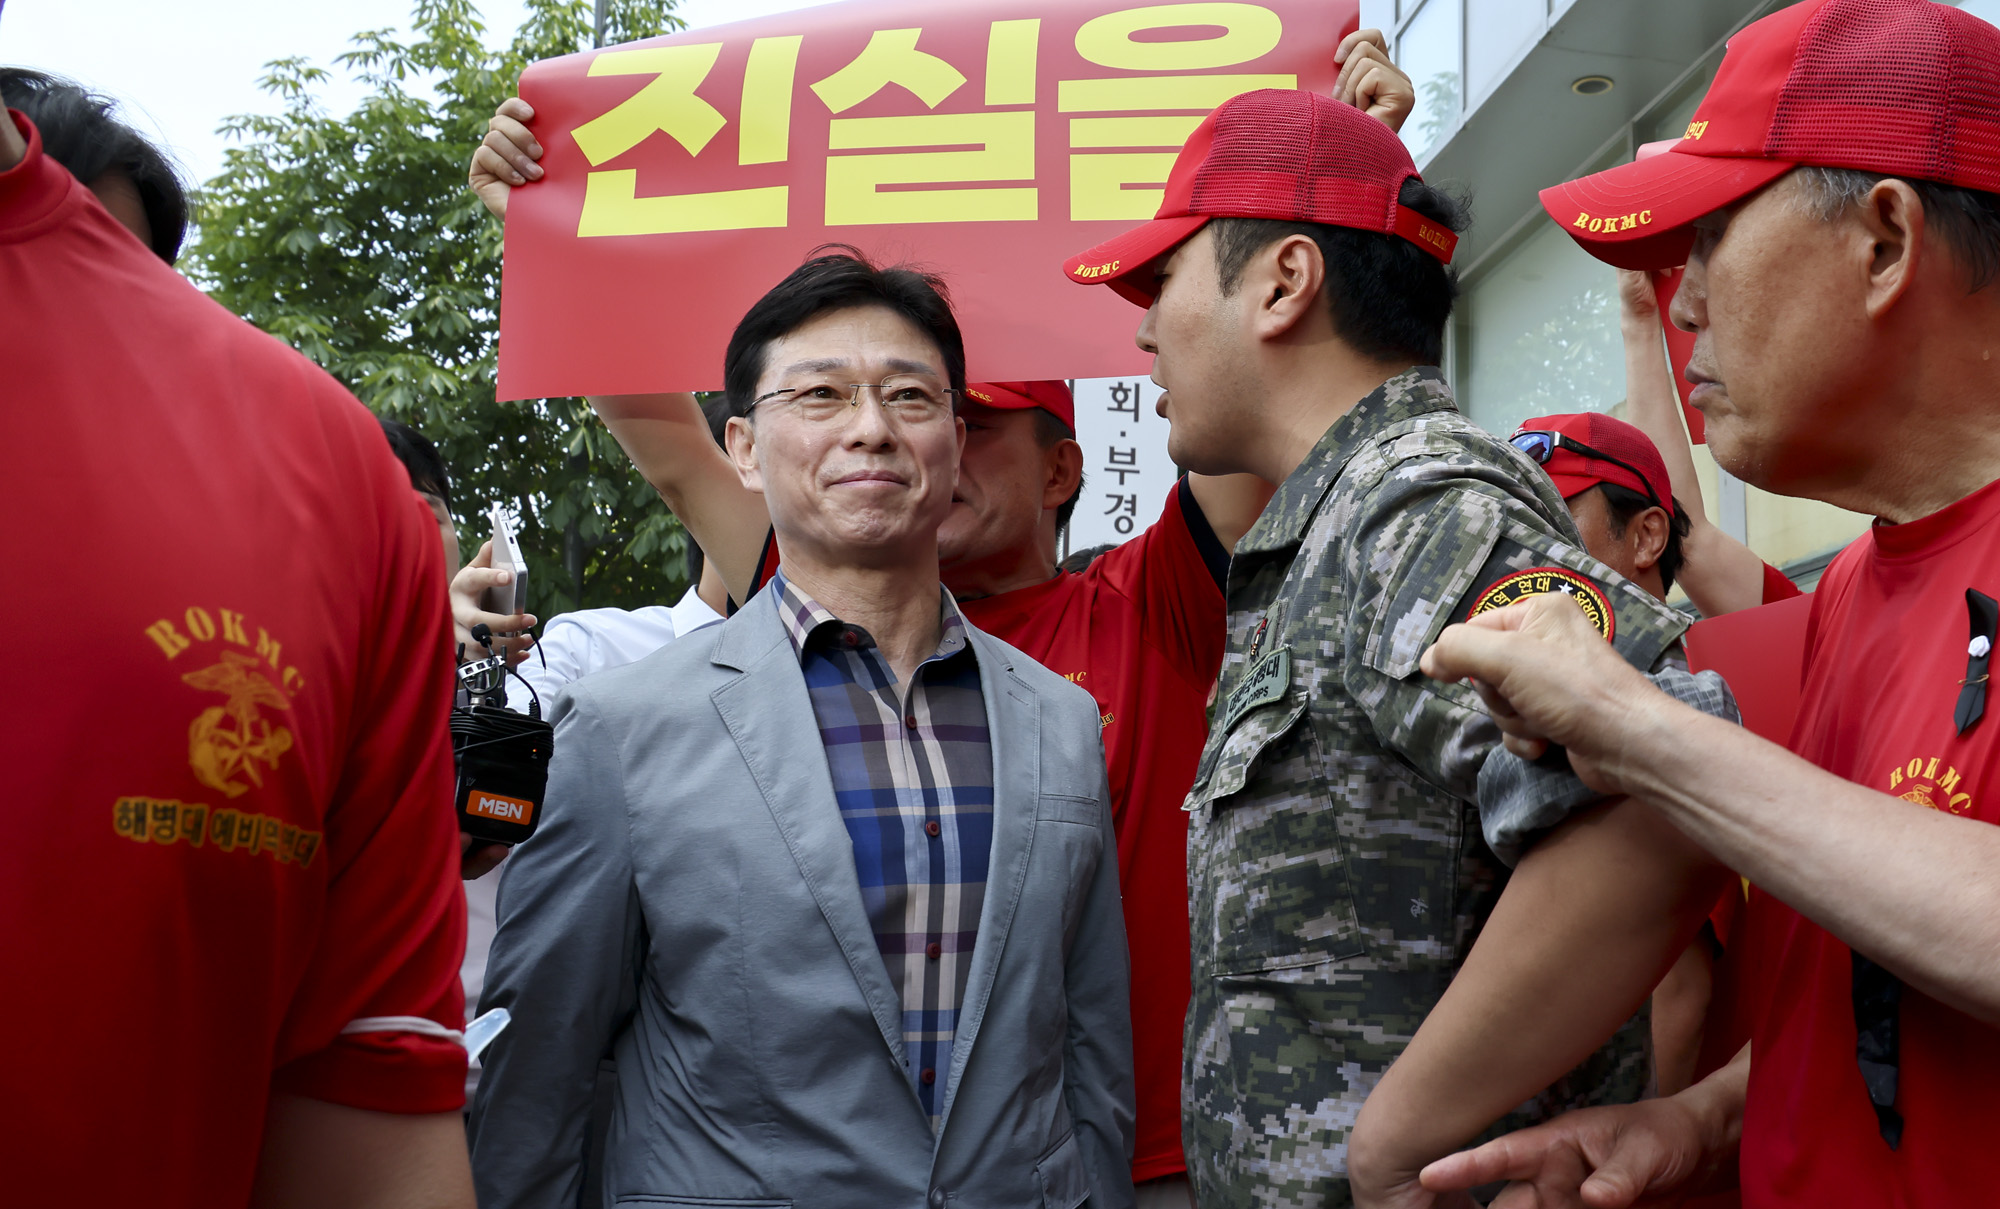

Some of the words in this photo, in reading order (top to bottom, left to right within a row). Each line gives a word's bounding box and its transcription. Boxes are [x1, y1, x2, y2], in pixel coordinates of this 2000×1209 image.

[571, 3, 1298, 238] 진실을
[1684, 121, 1709, 140] 연대
[1573, 210, 1652, 233] ROKMC
[1073, 260, 1120, 278] ROKMC
[145, 606, 304, 697] ROKMC
[1890, 757, 1972, 814] ROKMC
[478, 797, 523, 820] MBN
